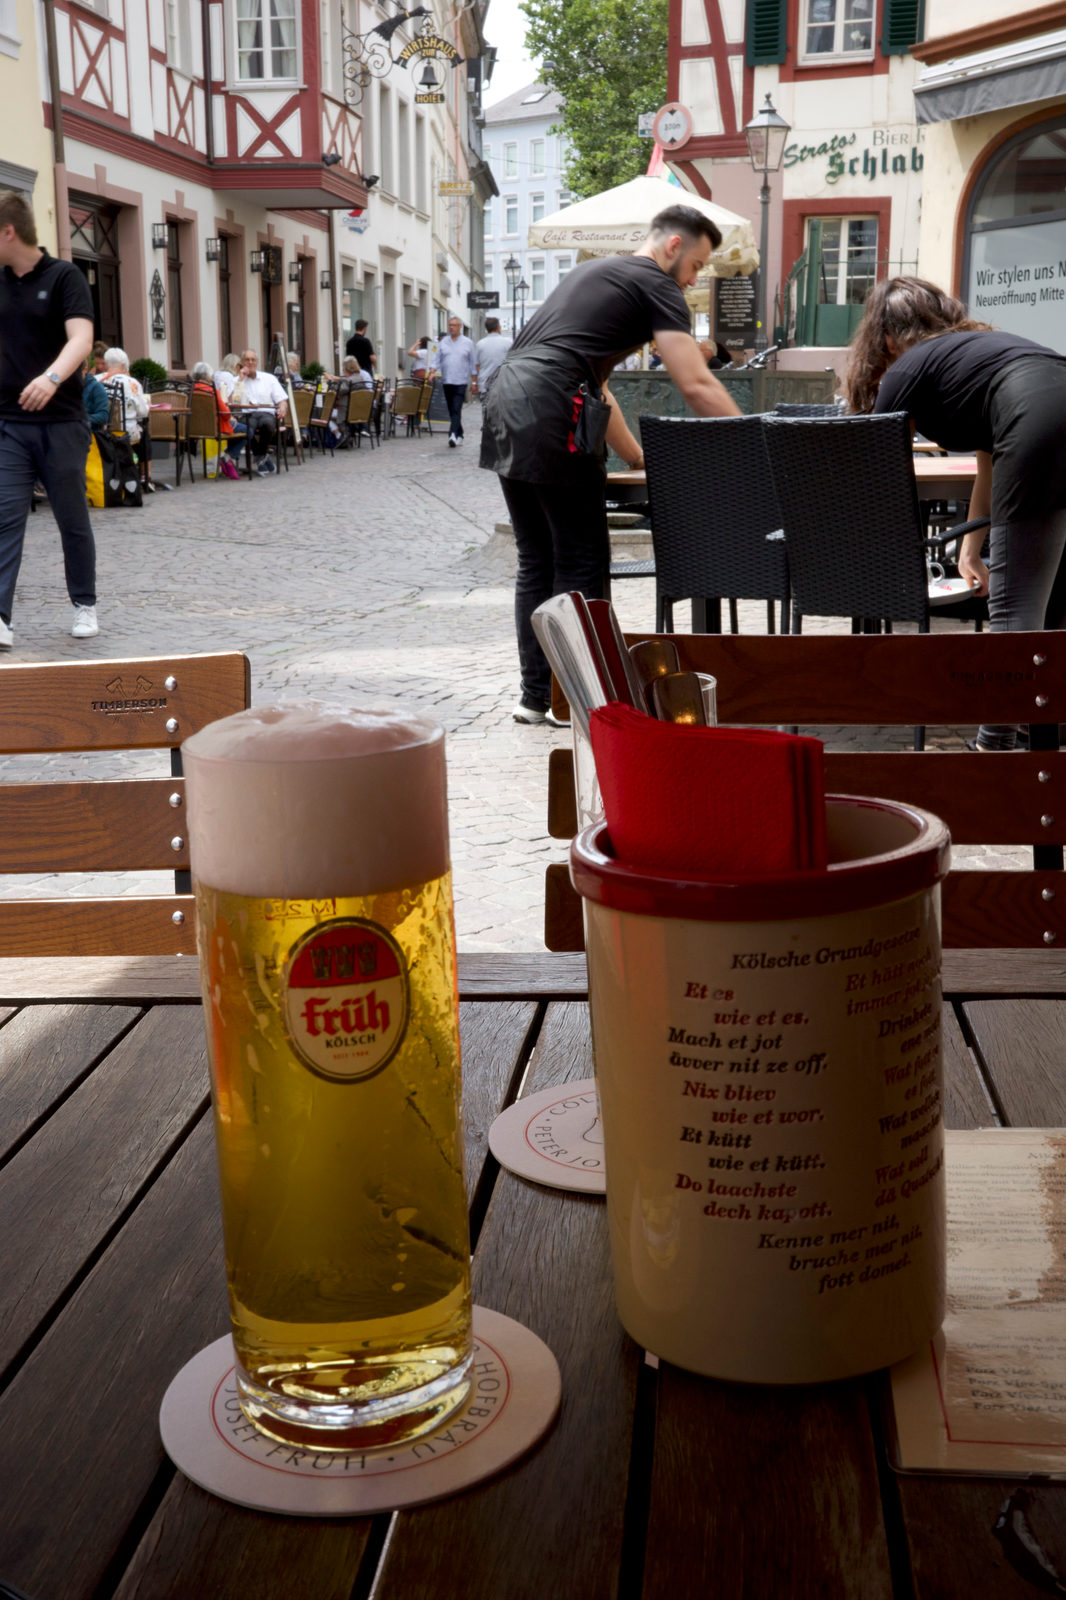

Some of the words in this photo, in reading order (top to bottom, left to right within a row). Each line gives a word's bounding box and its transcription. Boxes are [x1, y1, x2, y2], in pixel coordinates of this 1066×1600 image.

[400, 37, 457, 60] WIRTSHAUS
[416, 94, 442, 103] HOTEL
[784, 132, 856, 168] Stratos
[542, 229, 567, 244] Café
[571, 230, 627, 241] Restaurant
[976, 269, 995, 286] Wir
[998, 265, 1030, 288] stylen
[1034, 266, 1054, 281] uns
[976, 290, 1037, 307] Neueröffnung
[1040, 287, 1065, 302] Mitte
[91, 698, 167, 711] TIMBERSON
[730, 950, 811, 970] Kölsche
[684, 982, 708, 999] Et
[844, 973, 865, 992] Et
[714, 1009, 750, 1025] wie
[756, 1011, 776, 1025] et
[782, 1012, 810, 1025] es.
[846, 998, 902, 1017] immer
[325, 1033, 376, 1048] KÖLSCH
[668, 1026, 722, 1049] Mach
[728, 1034, 748, 1049] et
[750, 1034, 783, 1053] jot
[729, 1058, 760, 1073] nit
[766, 1060, 788, 1073] ze
[794, 1052, 828, 1075] off.
[682, 1080, 719, 1101] Nix
[724, 1084, 776, 1101] bliev
[711, 1108, 748, 1125] wie
[753, 1109, 774, 1124] et
[779, 1108, 825, 1124] wor.
[878, 1110, 908, 1135] Wat
[534, 1126, 568, 1158] PETER
[680, 1126, 702, 1144] Et
[707, 1130, 752, 1149] kütt
[708, 1154, 744, 1171] wie
[749, 1156, 770, 1172] et
[775, 1153, 826, 1172] kütt.
[875, 1161, 905, 1185] Wat
[675, 1173, 702, 1192] Do
[707, 1179, 797, 1198] laachste
[703, 1201, 751, 1221] dech
[757, 1233, 823, 1249] Kenne
[830, 1226, 868, 1245] mer
[789, 1248, 860, 1271] bruche
[864, 1239, 898, 1261] mer
[818, 1271, 855, 1294] fott
[411, 1361, 501, 1459] HOFBRÄU
[265, 1442, 366, 1470] FRÜH
